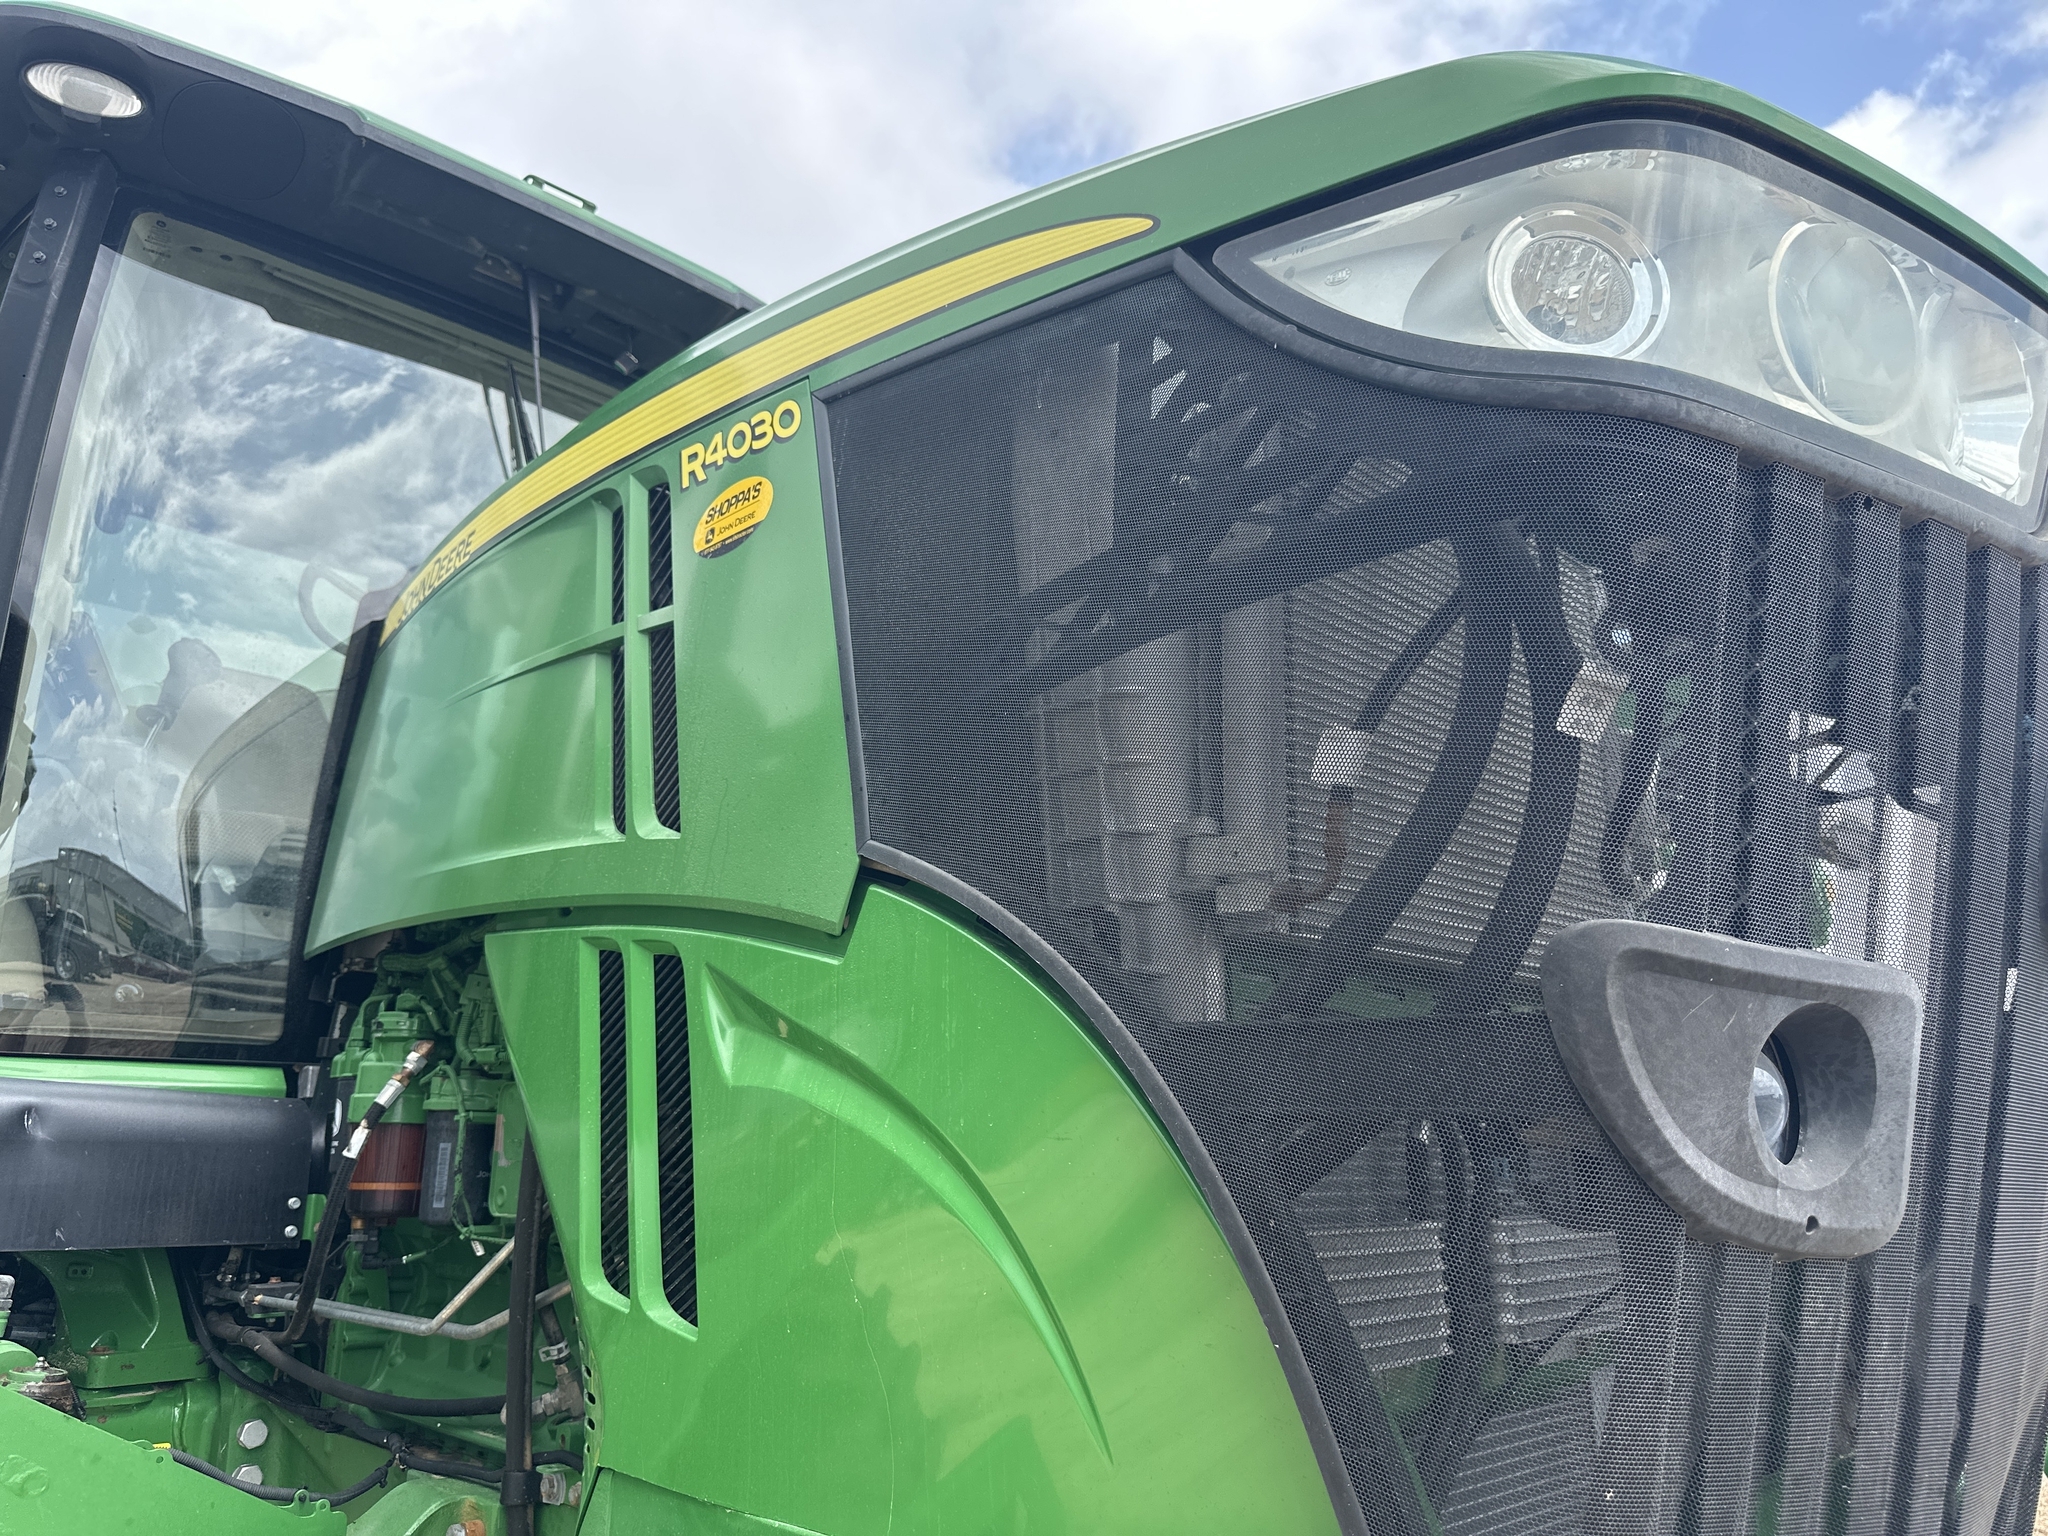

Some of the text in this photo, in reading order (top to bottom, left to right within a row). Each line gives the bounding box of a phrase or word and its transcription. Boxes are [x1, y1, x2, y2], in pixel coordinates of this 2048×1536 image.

[680, 399, 801, 490] R4030
[705, 481, 763, 525] SHOPPA'S
[717, 522, 735, 537] JOHN
[734, 510, 756, 528] DEERE
[427, 529, 477, 590] DEERE
